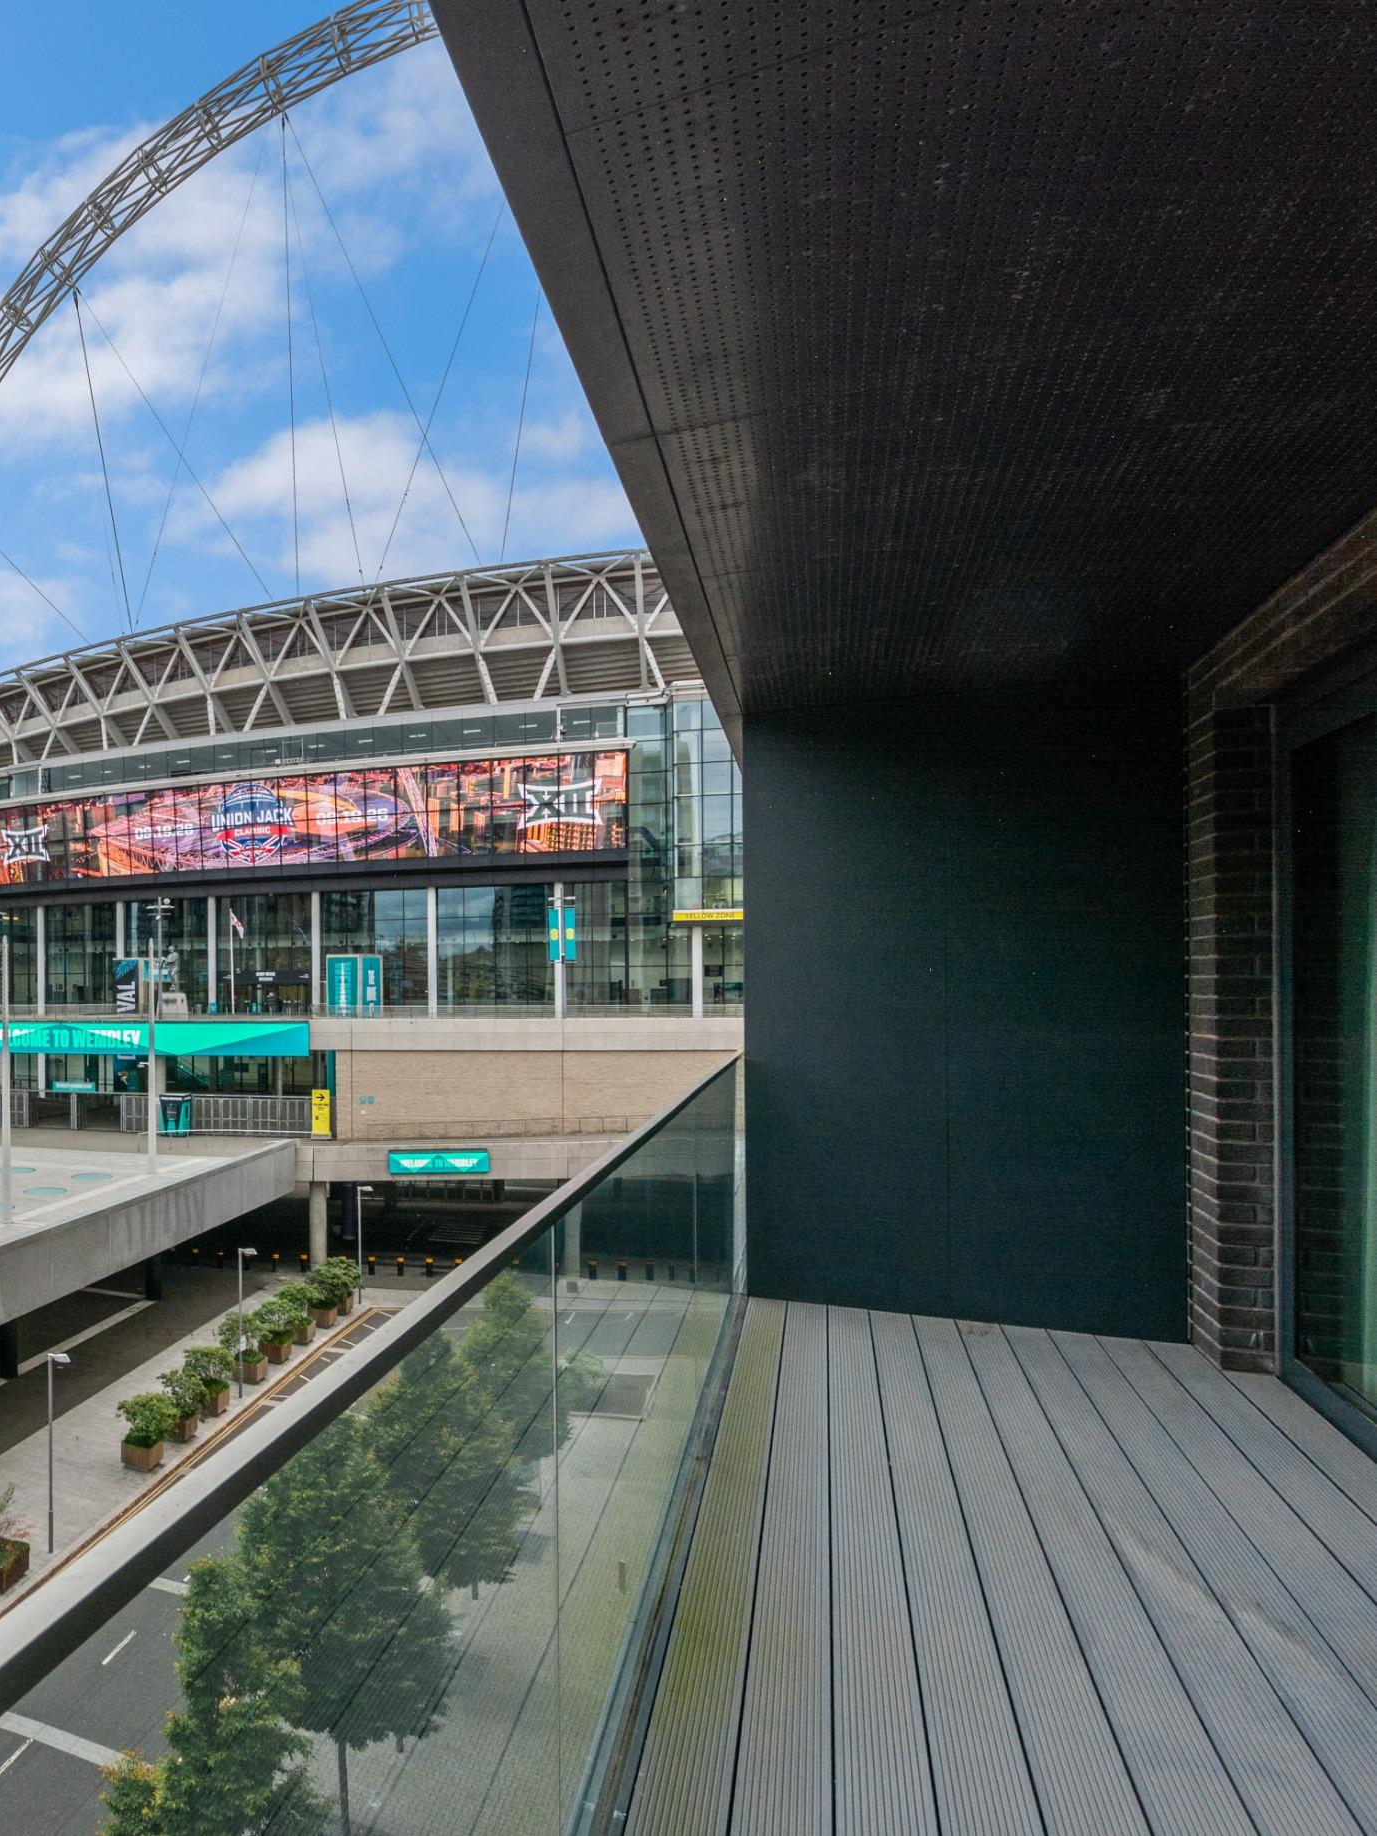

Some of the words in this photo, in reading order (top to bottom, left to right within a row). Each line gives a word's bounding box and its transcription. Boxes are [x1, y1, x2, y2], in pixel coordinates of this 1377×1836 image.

[211, 810, 252, 833] UNION
[256, 806, 293, 827] JACK
[234, 826, 271, 837] CLASSIC
[686, 912, 714, 920] YELLOW
[714, 911, 736, 919] ZONE
[52, 1029, 70, 1048] TO
[72, 1029, 142, 1049] WEMBLEY
